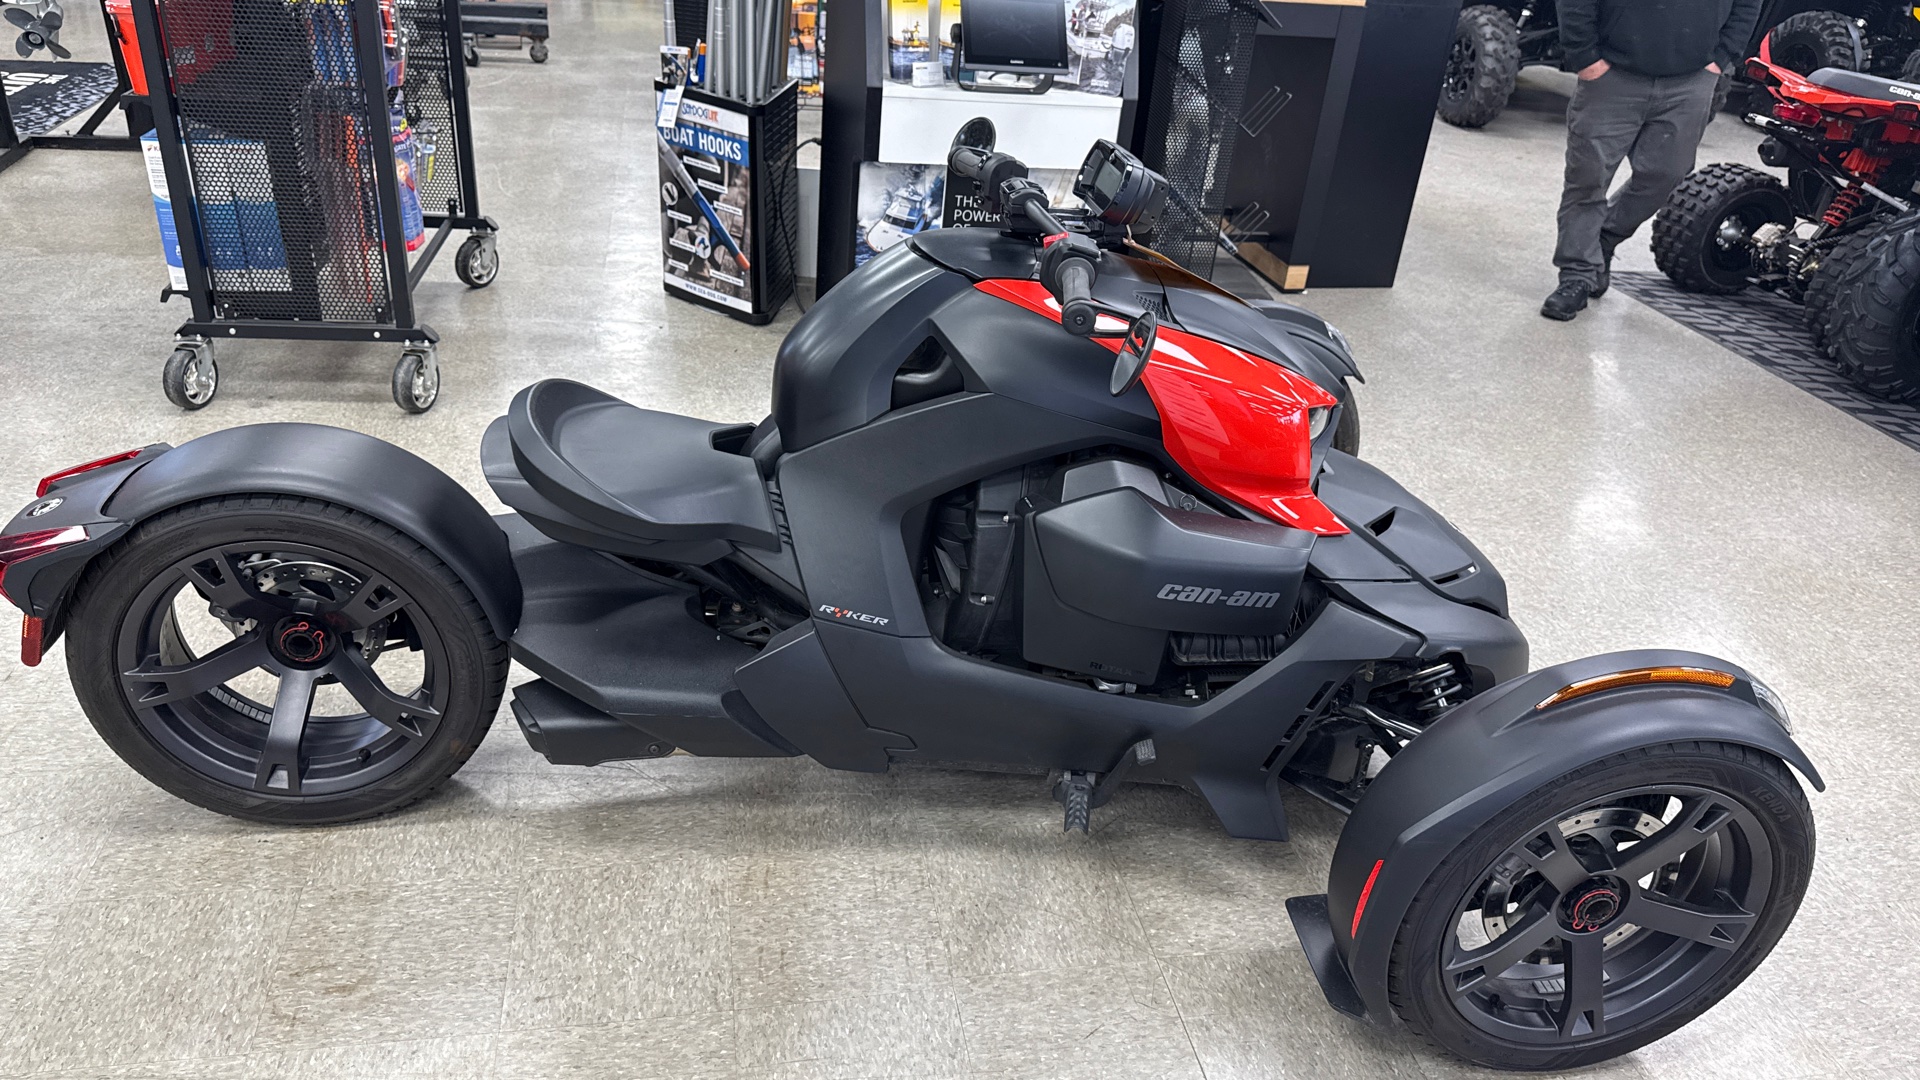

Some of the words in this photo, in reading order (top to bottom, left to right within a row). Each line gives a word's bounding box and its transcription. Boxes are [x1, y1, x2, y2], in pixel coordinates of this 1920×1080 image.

[1889, 85, 1920, 101] can-a
[663, 126, 694, 147] BOAT
[698, 131, 742, 161] HOOKS
[953, 208, 1001, 223] POWER
[819, 604, 889, 626] RYKER
[1751, 785, 1792, 822] KENDA
